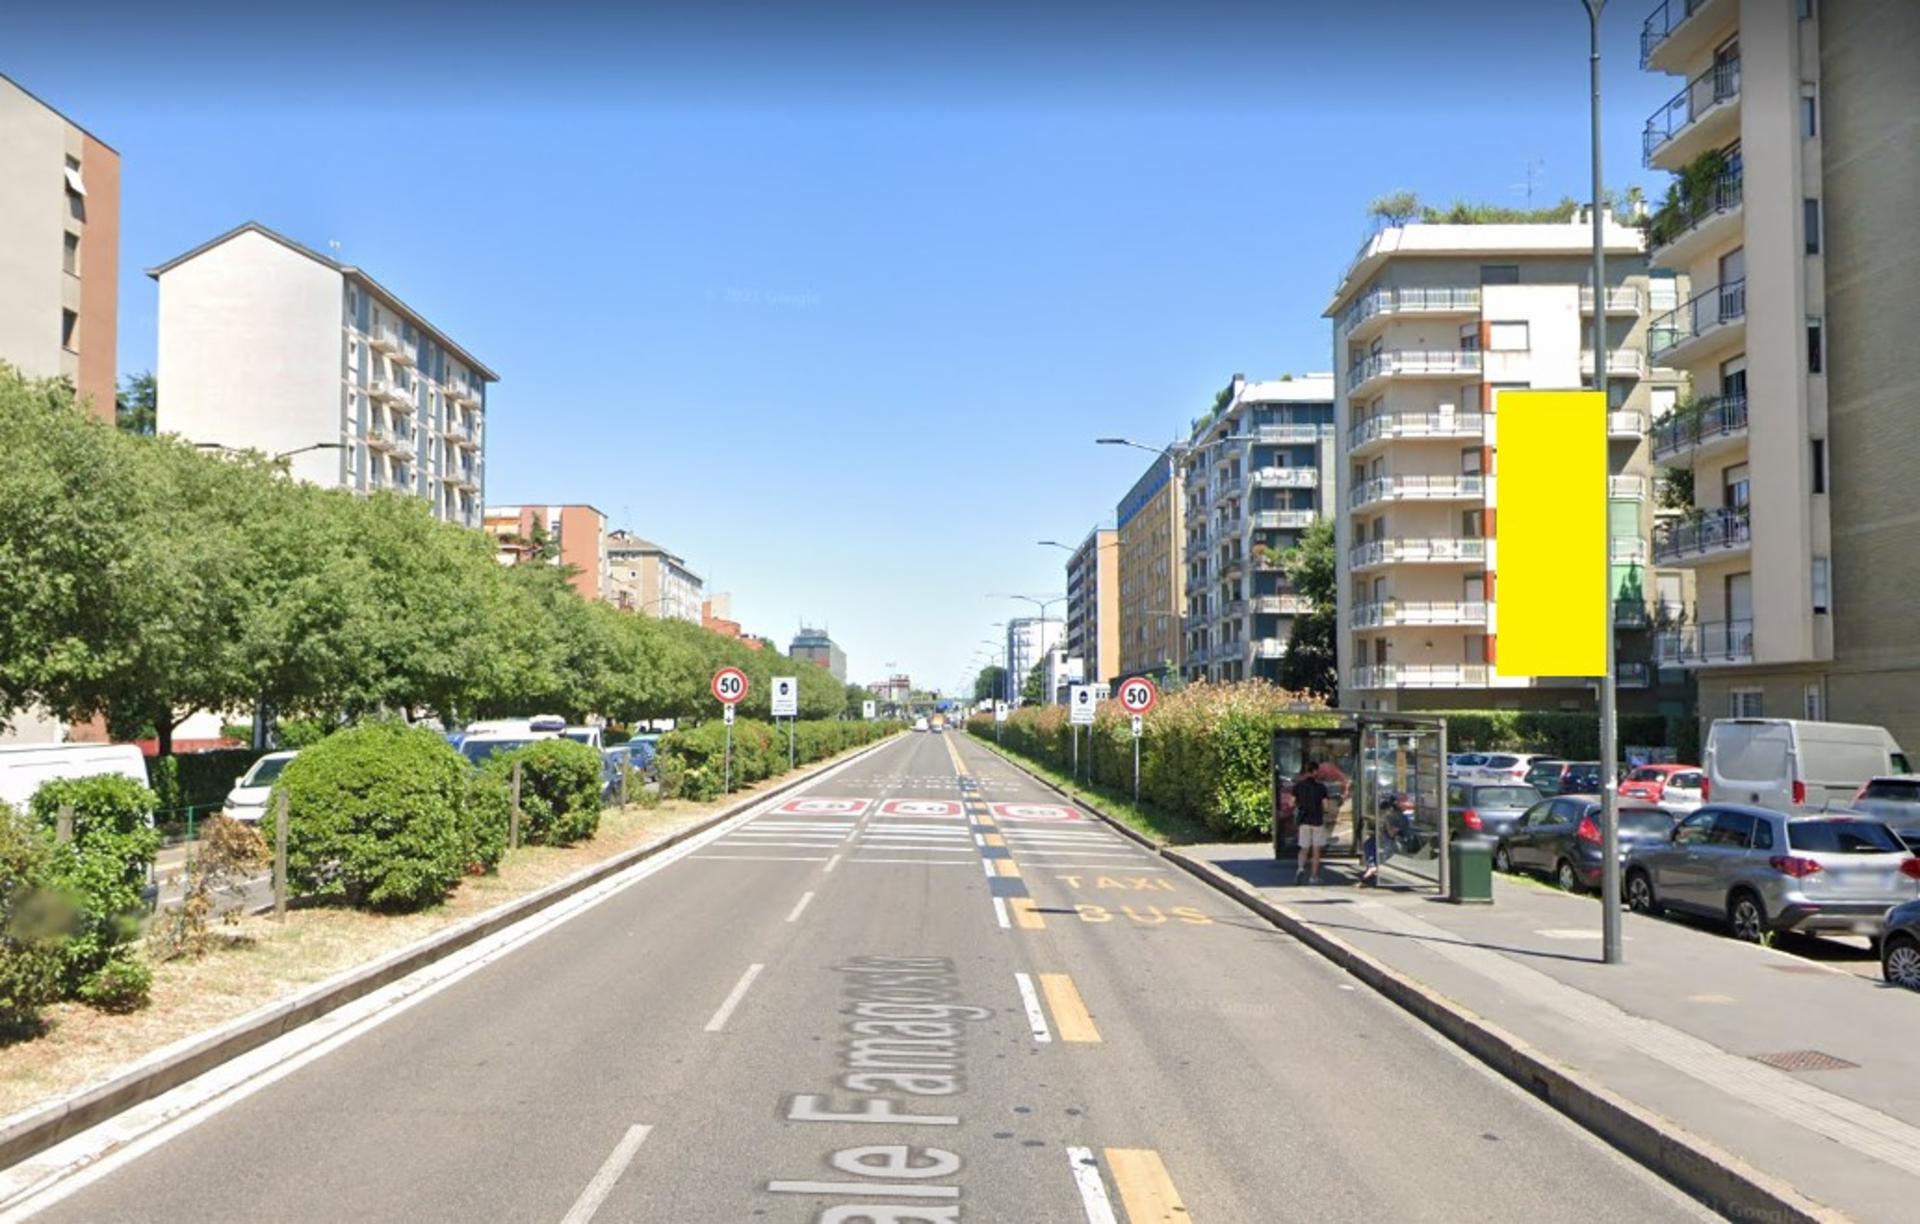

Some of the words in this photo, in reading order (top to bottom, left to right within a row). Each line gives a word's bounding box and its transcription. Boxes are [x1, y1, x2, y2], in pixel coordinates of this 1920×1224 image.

[720, 677, 741, 693] 50
[1127, 688, 1148, 704] 50
[1056, 875, 1176, 892] TAXI
[1074, 904, 1214, 925] BUS
